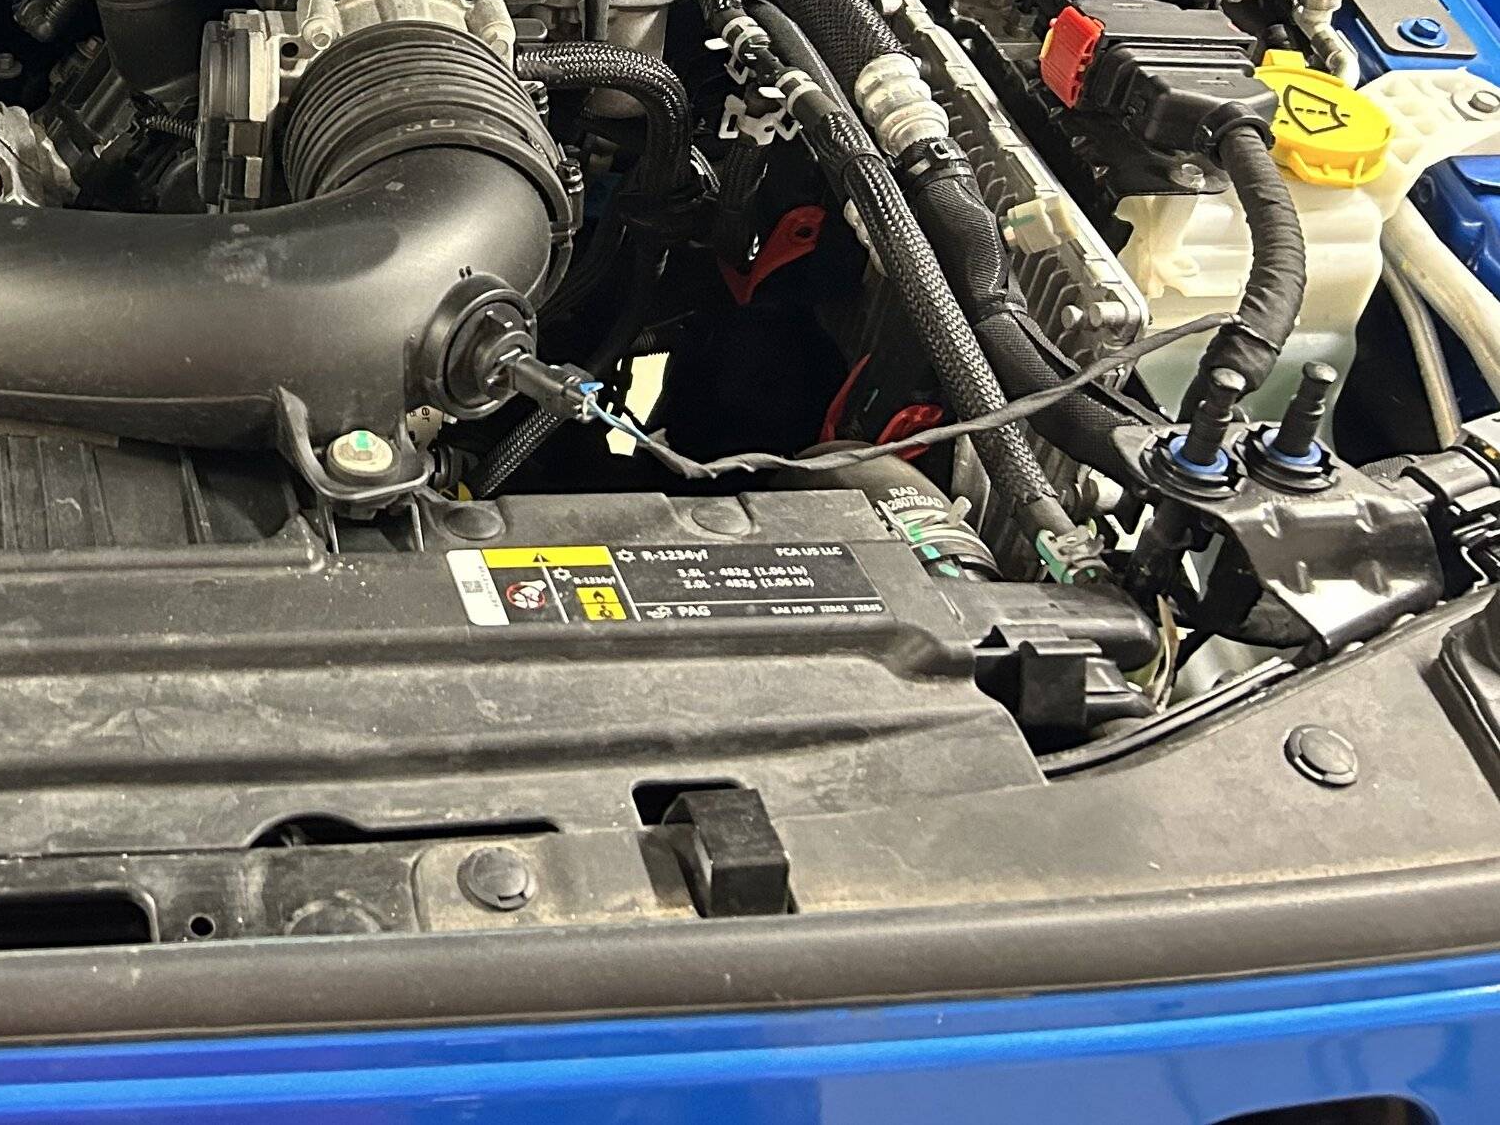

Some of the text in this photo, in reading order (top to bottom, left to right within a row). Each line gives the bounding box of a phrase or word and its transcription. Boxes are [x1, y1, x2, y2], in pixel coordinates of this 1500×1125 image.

[888, 486, 919, 497] RAD
[641, 549, 708, 563] R-1234yf
[776, 546, 842, 557] FCA US LLC
[677, 606, 711, 618] PAG
